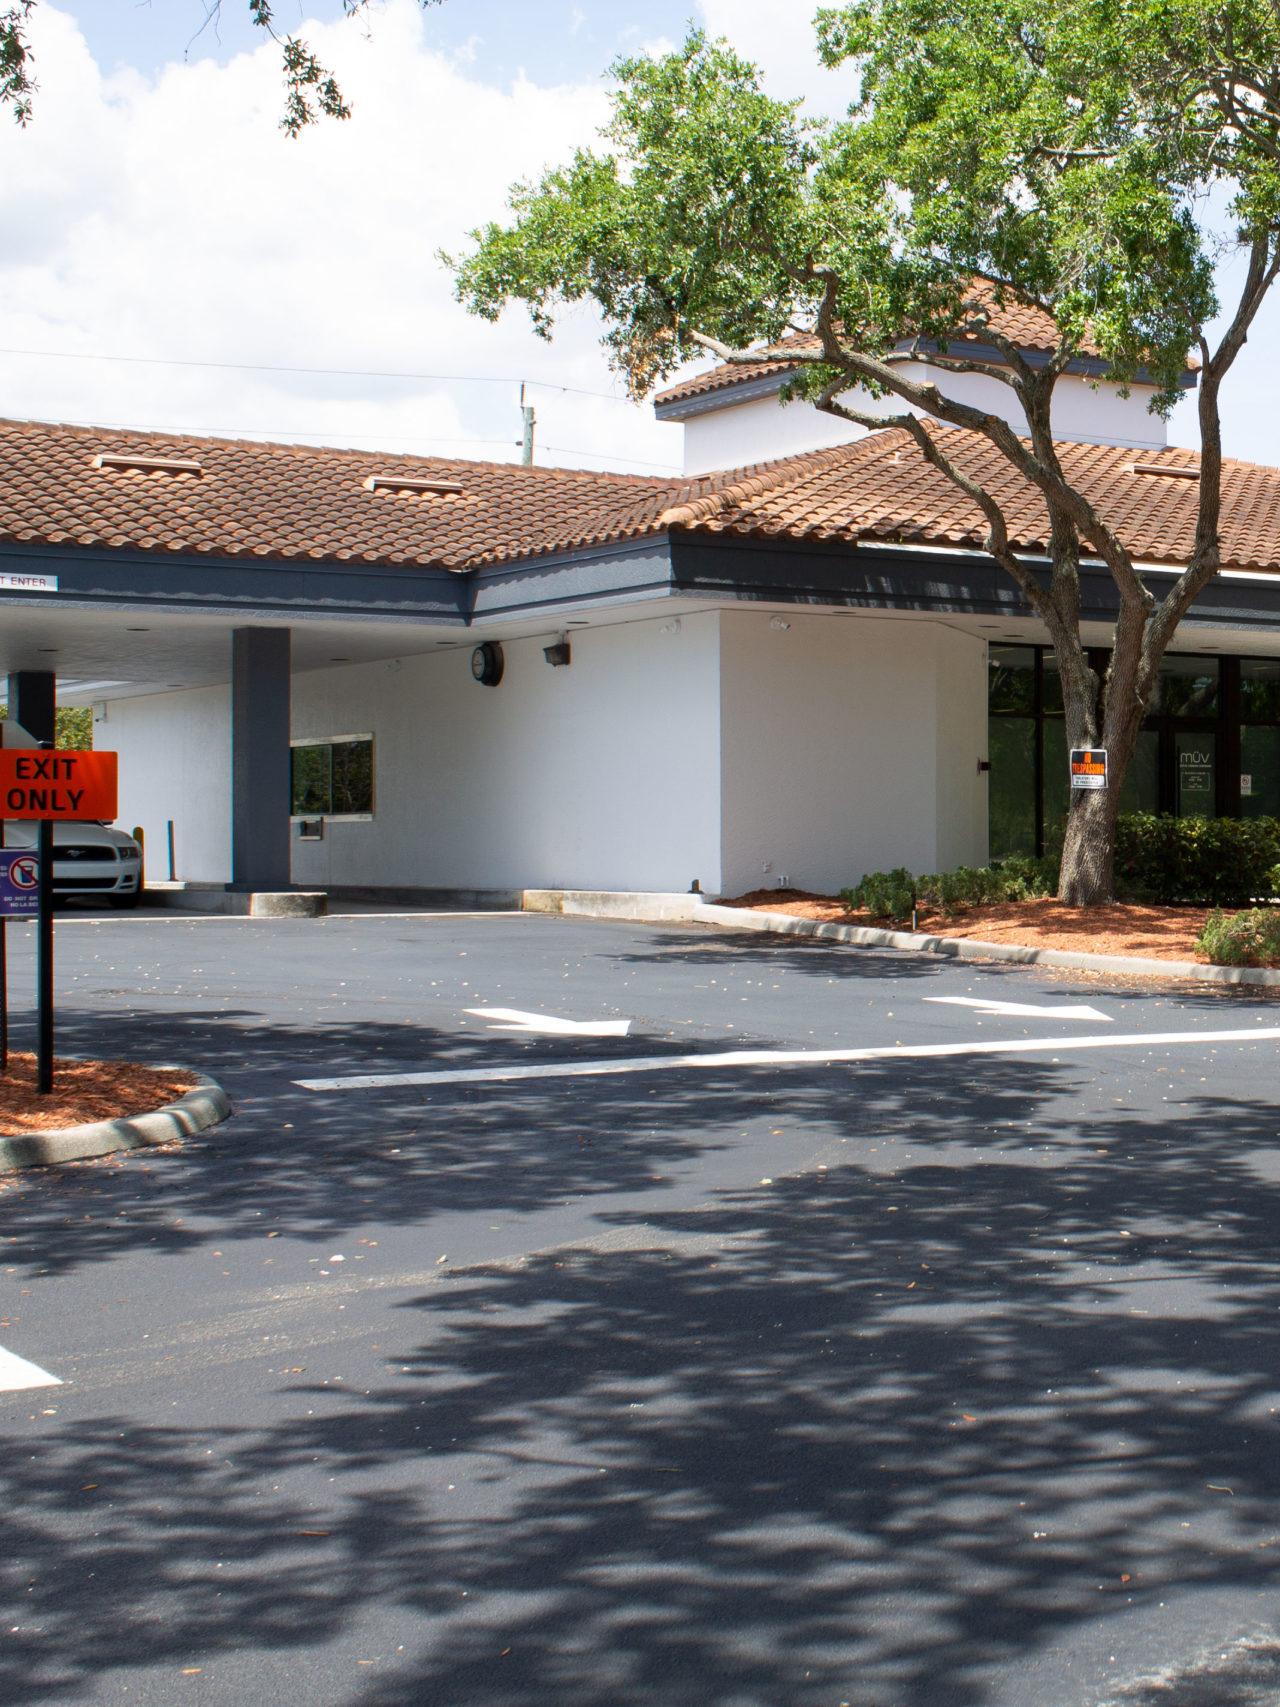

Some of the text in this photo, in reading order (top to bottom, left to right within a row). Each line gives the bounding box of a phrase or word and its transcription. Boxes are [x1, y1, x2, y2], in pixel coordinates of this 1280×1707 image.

[11, 576, 47, 586] ENTER
[16, 757, 77, 780] EXIT
[6, 787, 85, 811] ONLY
